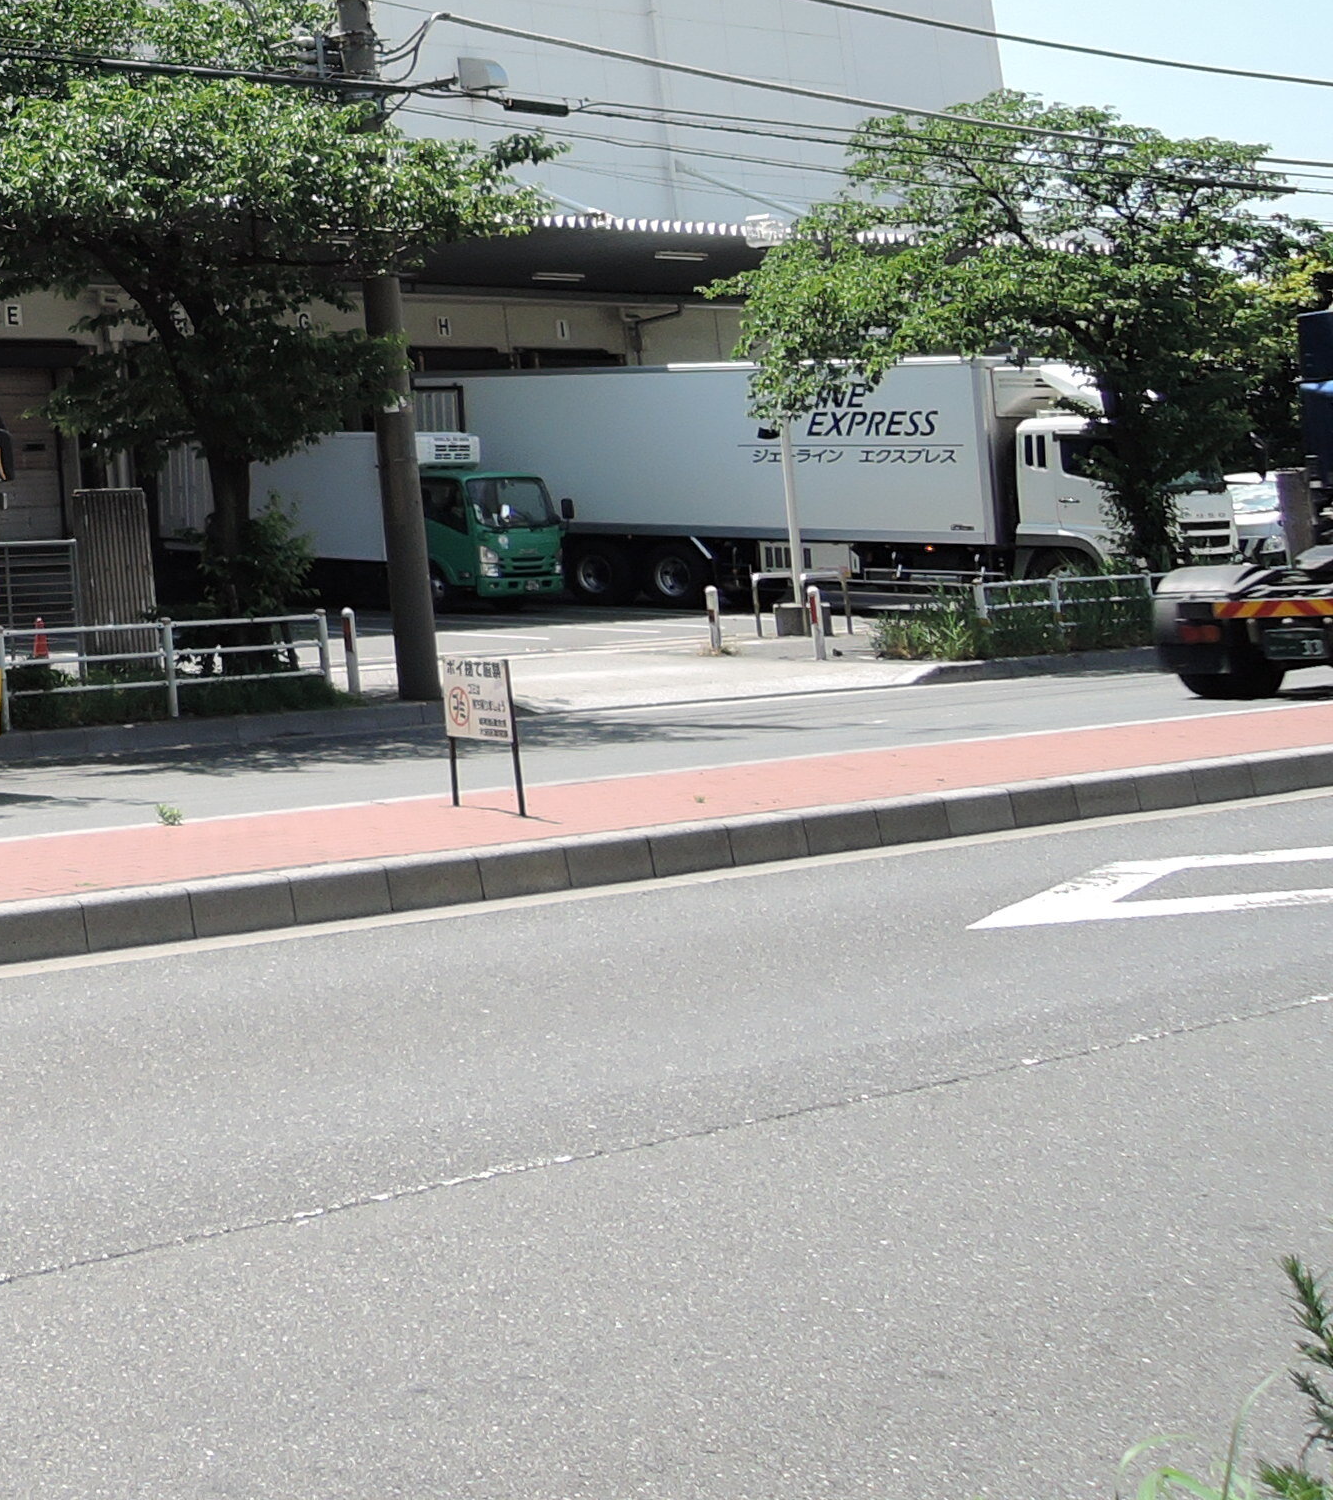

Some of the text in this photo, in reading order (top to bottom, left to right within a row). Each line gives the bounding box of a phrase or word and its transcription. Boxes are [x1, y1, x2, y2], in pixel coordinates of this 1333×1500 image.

[7, 306, 19, 325] E
[438, 318, 450, 336] H
[807, 410, 939, 437] EXPRESS
[752, 449, 843, 463] ジェライン
